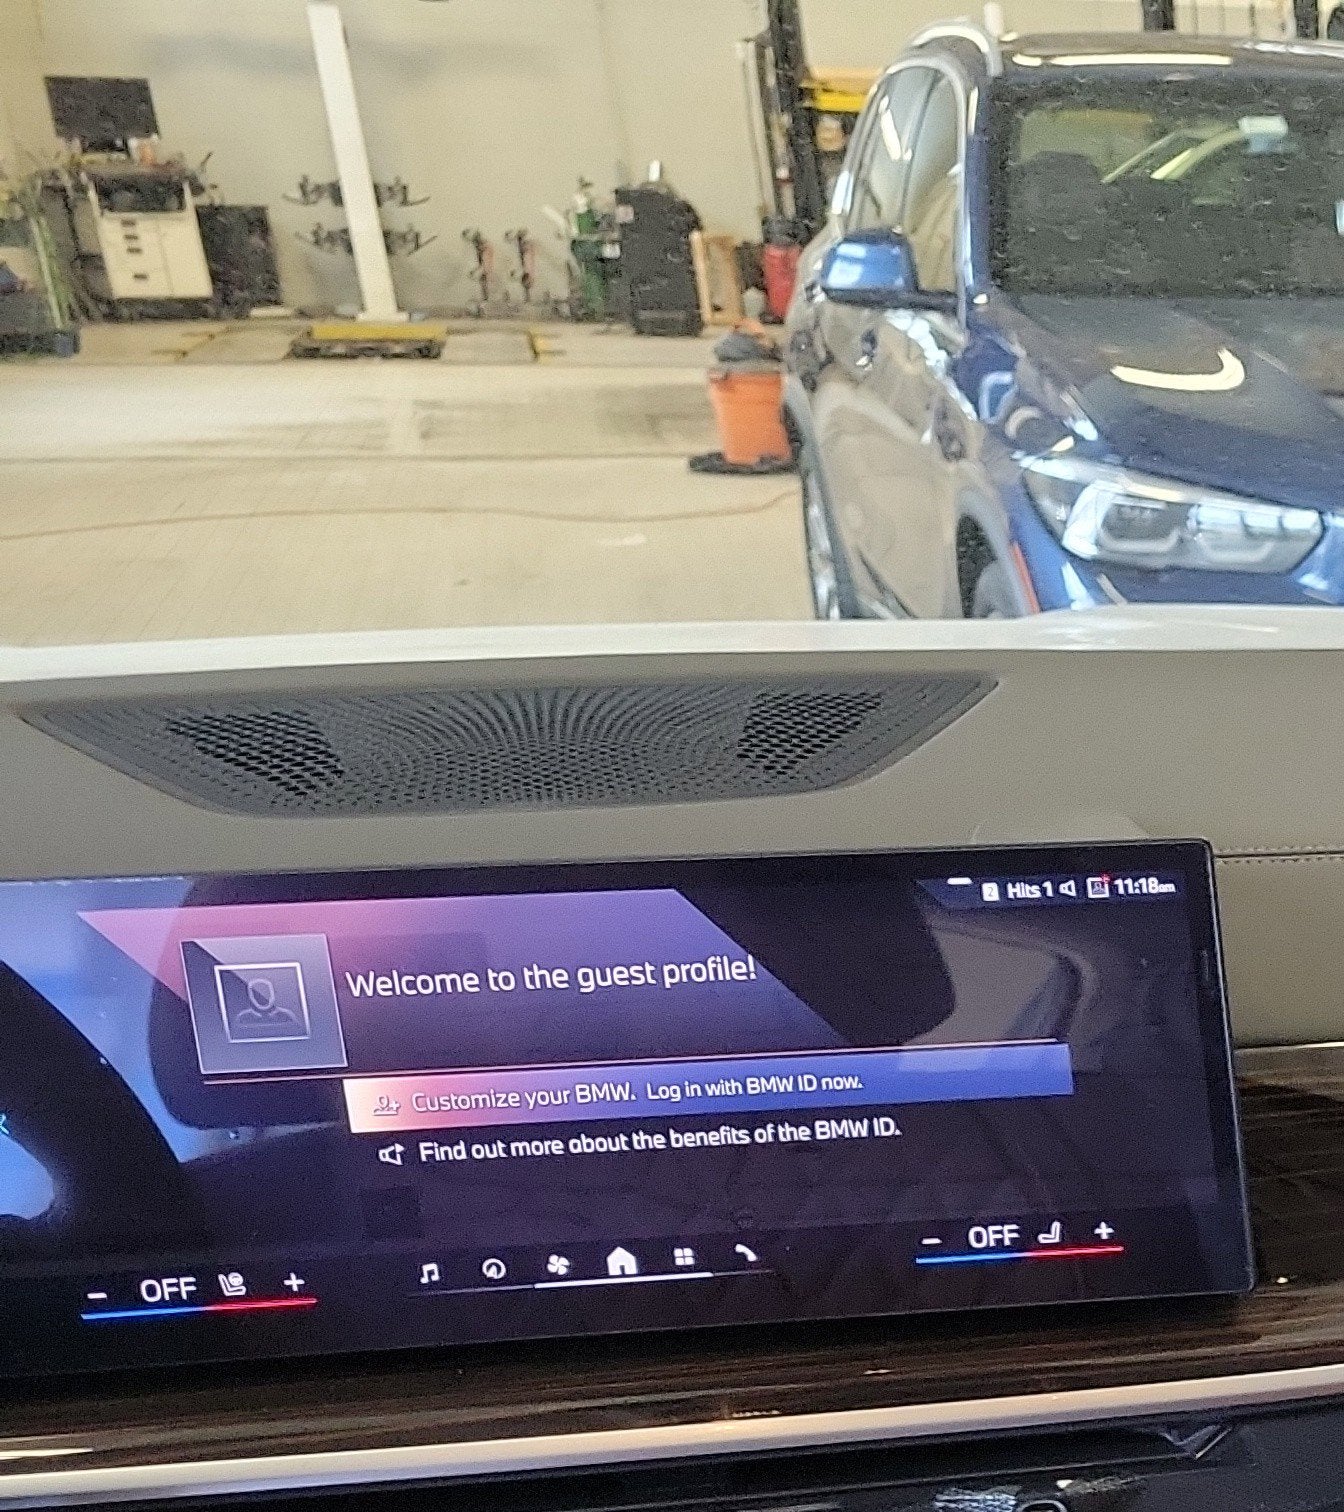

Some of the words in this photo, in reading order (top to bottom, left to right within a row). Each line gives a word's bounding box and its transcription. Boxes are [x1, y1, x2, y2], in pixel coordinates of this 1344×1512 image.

[346, 966, 479, 999] Welcome
[485, 968, 516, 993] to
[523, 962, 570, 991] the
[577, 961, 657, 994] guest
[662, 954, 757, 991] profile!
[411, 1088, 521, 1113] Customize
[524, 1089, 571, 1111] your
[574, 1082, 637, 1105] BMW.
[646, 1082, 681, 1103] Log
[685, 1080, 702, 1098] in
[704, 1077, 743, 1097] with
[746, 1074, 794, 1095] BMW
[797, 1074, 817, 1092] ID
[821, 1075, 864, 1091] now.
[418, 1139, 468, 1163] Find
[471, 1140, 507, 1160] out
[510, 1139, 565, 1158] more
[568, 1133, 629, 1155] about
[632, 1129, 666, 1150] the
[669, 1125, 751, 1149] benefits
[753, 1123, 776, 1144] of
[777, 1121, 811, 1142] the
[814, 1118, 869, 1140] BMW
[873, 1116, 902, 1138] ID.
[968, 1224, 1020, 1249] OFF
[139, 1276, 198, 1303] OFF
